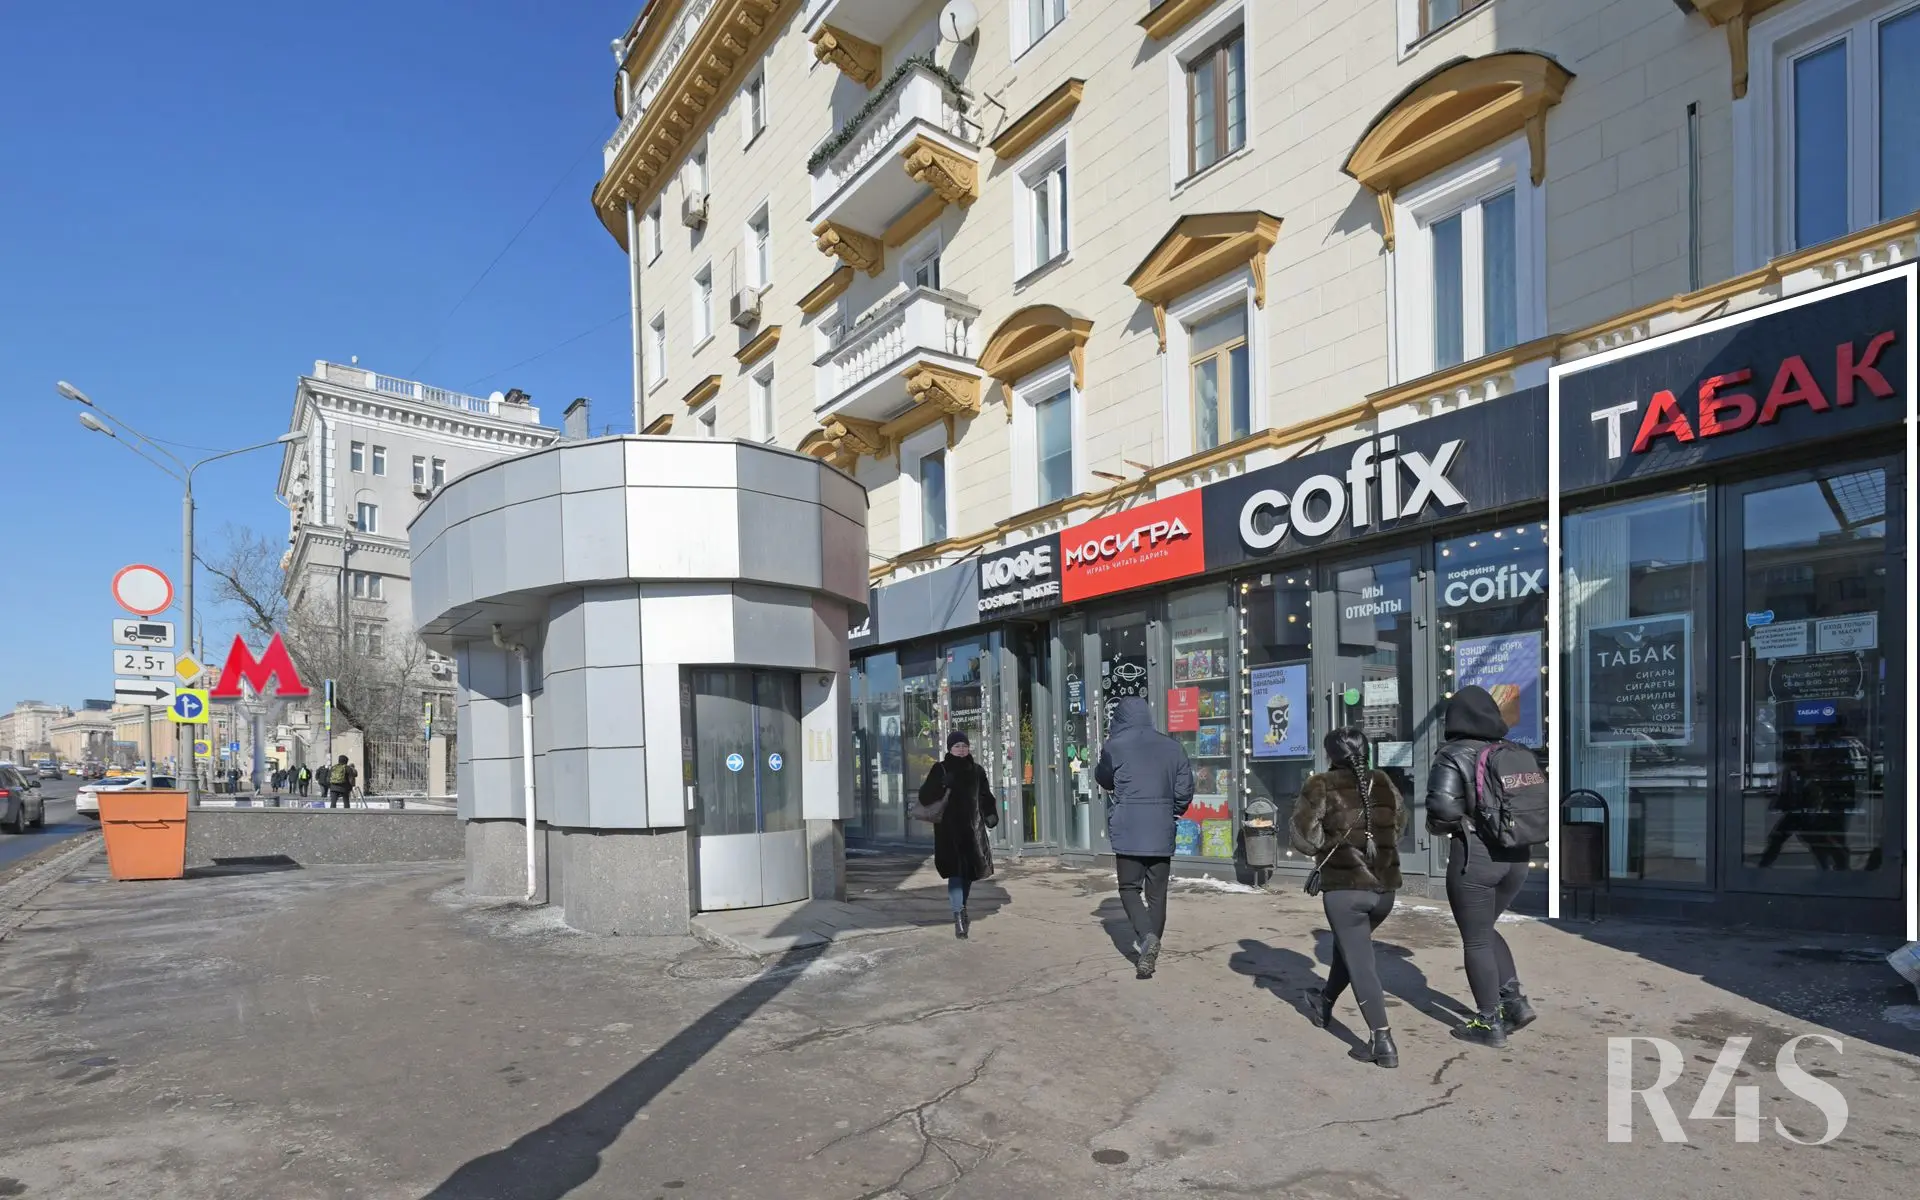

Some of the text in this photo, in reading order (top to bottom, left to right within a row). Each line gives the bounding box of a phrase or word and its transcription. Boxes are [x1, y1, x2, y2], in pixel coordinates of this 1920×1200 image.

[1591, 330, 1896, 459] ТАБАК
[1239, 434, 1467, 549] cofix
[1065, 517, 1190, 567] МОСИГРА
[981, 545, 1052, 590] КОФЕ
[1086, 550, 1169, 576] ИГРАТЬ ЧИТАТЬ ДАРИТЬ
[1362, 584, 1384, 600] МЫ
[1444, 564, 1545, 607] cofix
[1346, 599, 1402, 620] ОТКРЫТЫ
[1597, 644, 1676, 668] ТАБАК
[1636, 669, 1675, 679] СИГАРЫ
[1625, 680, 1676, 691] СИГАРЕТЫ
[1616, 691, 1676, 703] СИГАРИЛЛЫ
[1651, 702, 1676, 711] VAPE
[1652, 713, 1677, 721] IQOS
